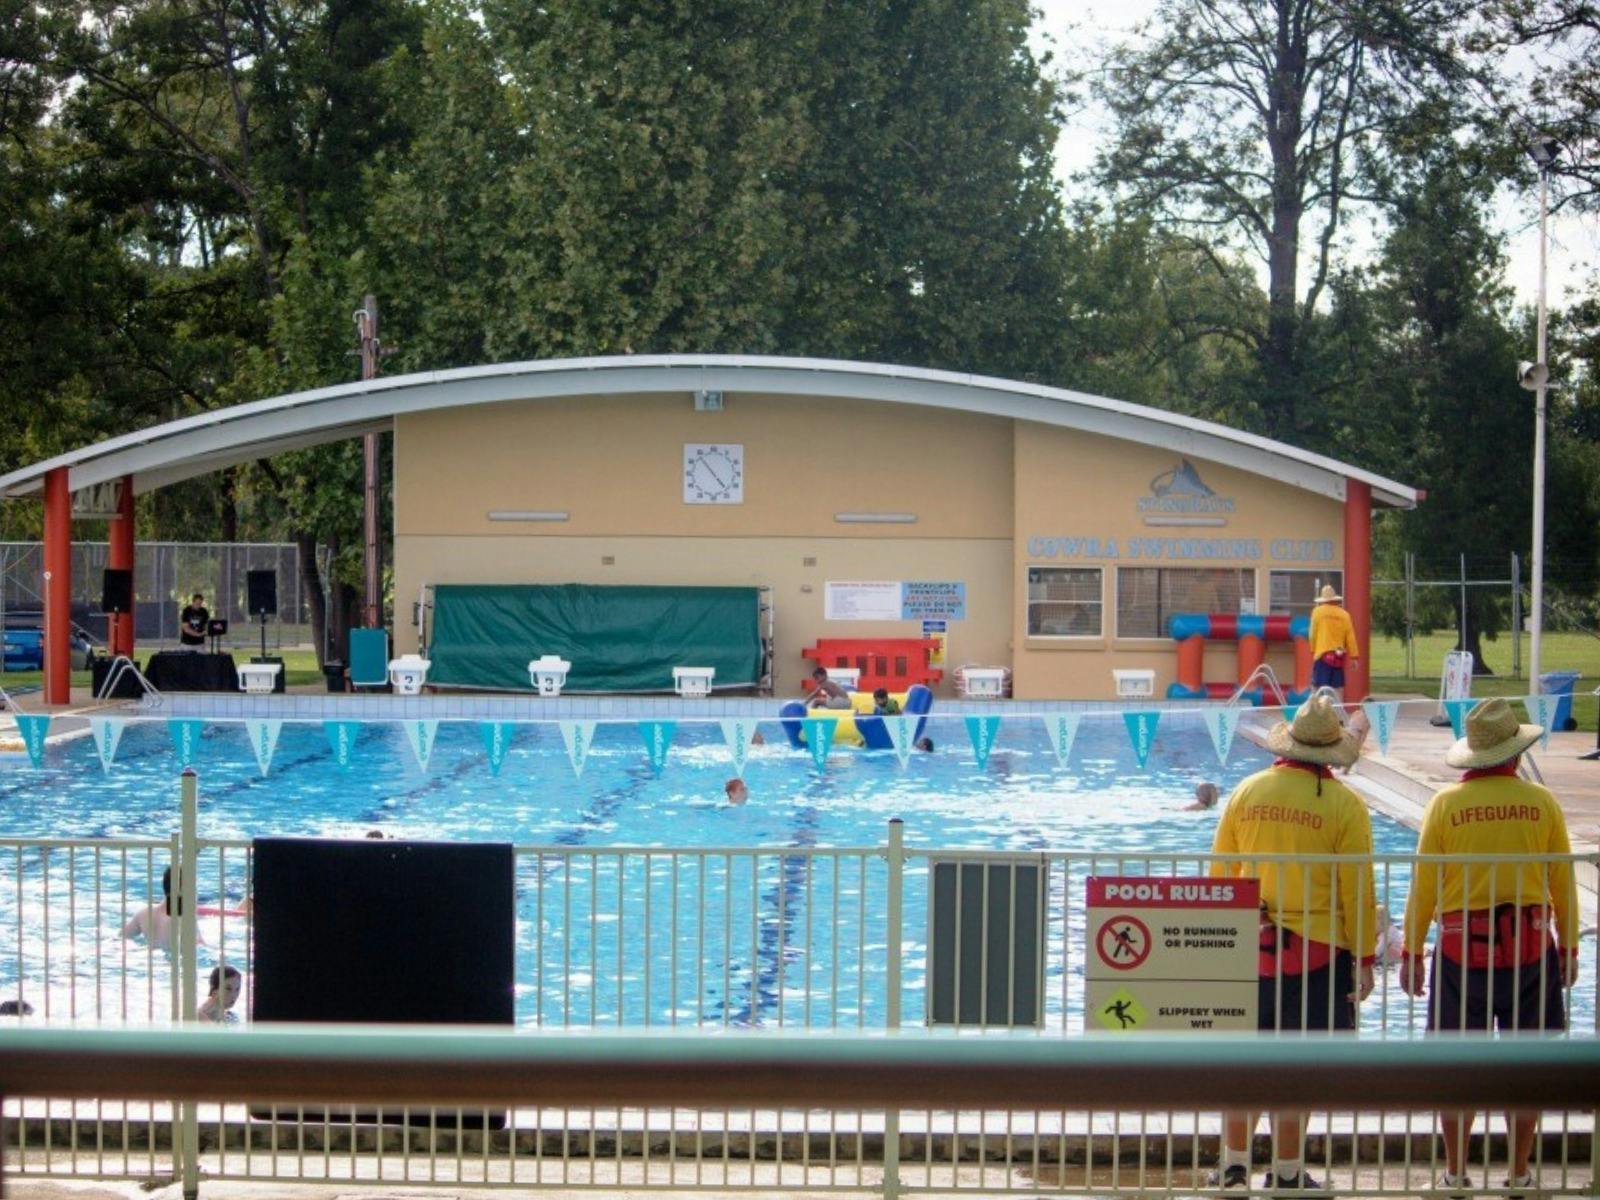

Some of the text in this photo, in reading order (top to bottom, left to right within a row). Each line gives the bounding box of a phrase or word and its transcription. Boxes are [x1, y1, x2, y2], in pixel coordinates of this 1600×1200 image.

[1027, 537, 1335, 561] COWRA SWIMMING CLUB
[404, 675, 414, 691] 2
[545, 677, 554, 692] 3
[1240, 804, 1323, 830] LIFEGUARD
[1451, 804, 1540, 827] LIFEGUARD
[1105, 884, 1234, 901] POOL RULES
[1163, 927, 1238, 936] NO RUNNING
[1165, 939, 1235, 949] OR PUSHING
[1159, 1007, 1246, 1017] SLIPPERY WHEN
[1191, 1020, 1213, 1029] WET
